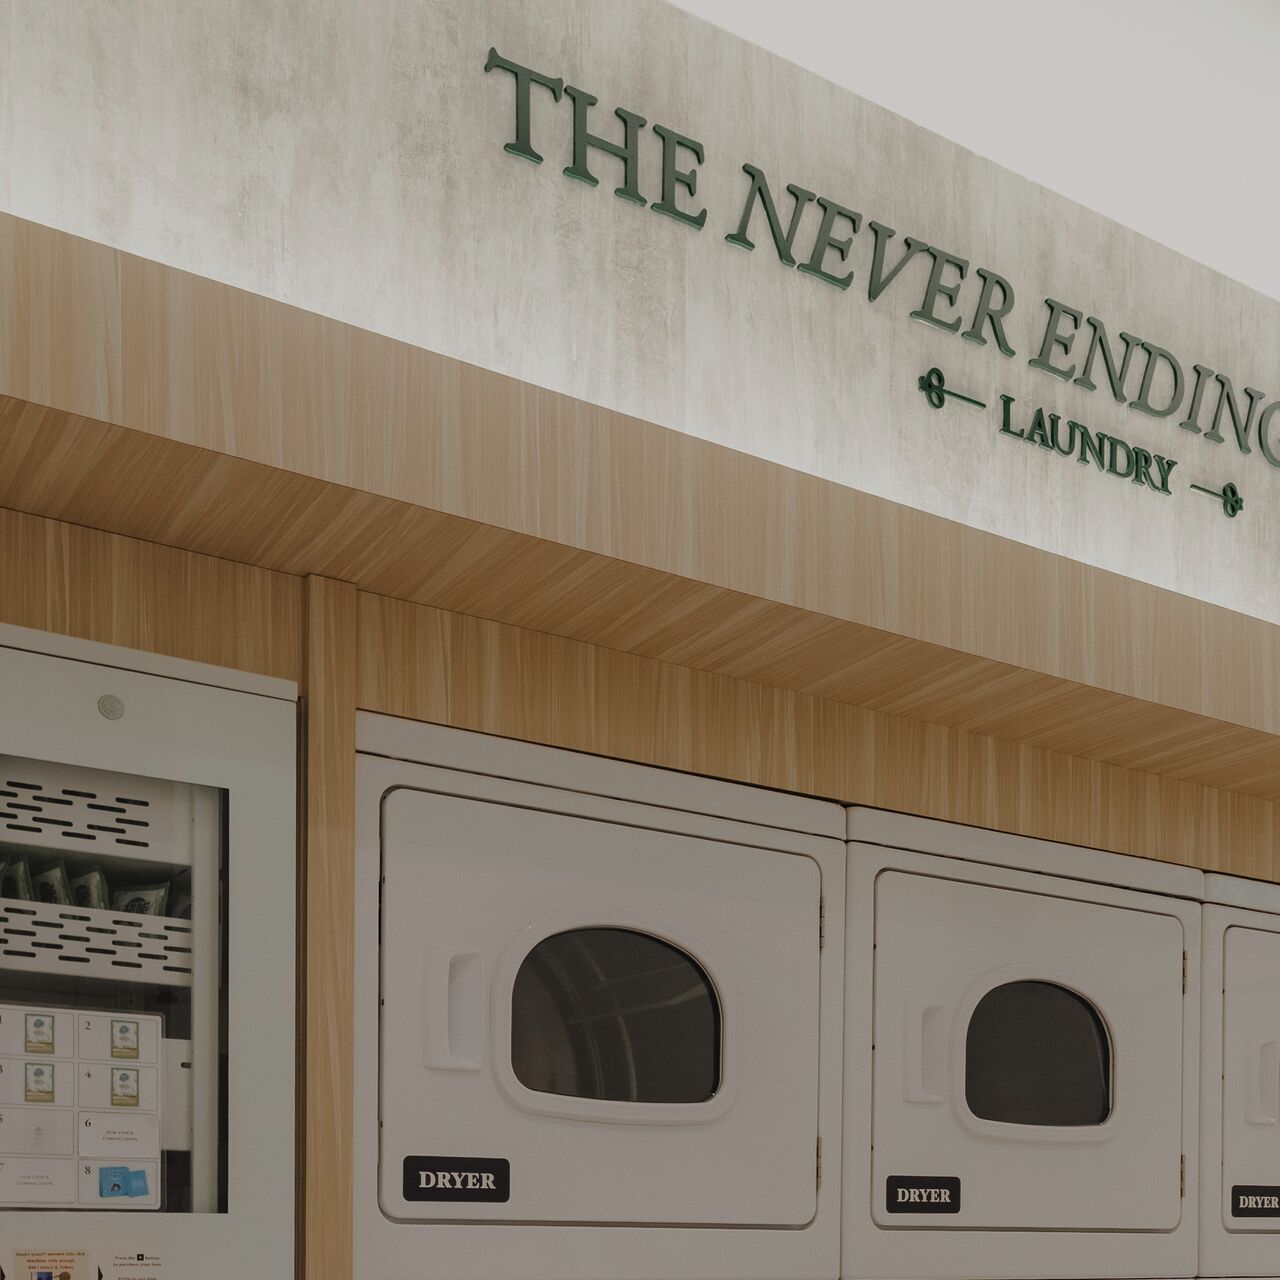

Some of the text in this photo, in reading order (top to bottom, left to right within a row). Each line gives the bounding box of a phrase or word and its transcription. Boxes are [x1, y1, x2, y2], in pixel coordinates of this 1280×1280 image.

[484, 45, 708, 229] THE
[725, 162, 1016, 358] NEVER
[998, 393, 1176, 494] LAUNDRY
[419, 1171, 496, 1189] DRYER
[897, 1188, 951, 1203] DRYER
[1239, 1195, 1280, 1209] DRYER
